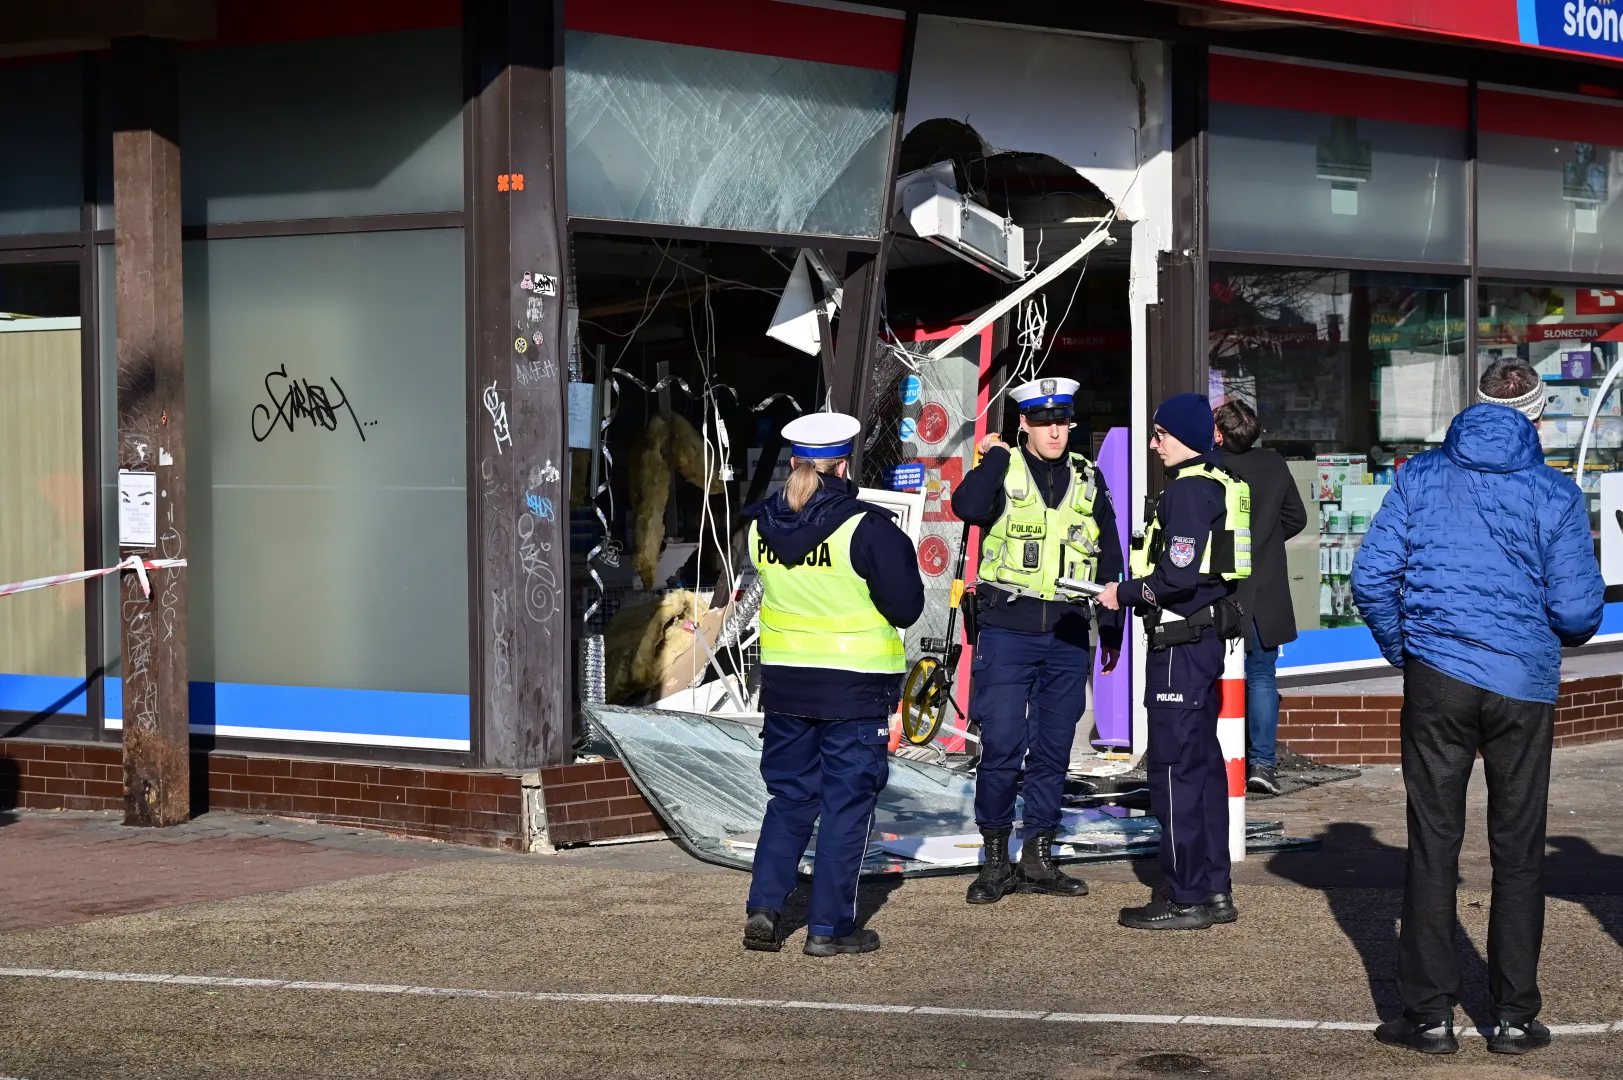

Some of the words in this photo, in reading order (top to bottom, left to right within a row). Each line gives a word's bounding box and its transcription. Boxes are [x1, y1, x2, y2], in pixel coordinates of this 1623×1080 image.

[1563, 0, 1623, 43] słon
[1543, 328, 1599, 338] SŁONECZNA
[1011, 523, 1042, 534] POLICJA
[757, 538, 832, 567] POJA
[1156, 693, 1184, 702] POLICJA
